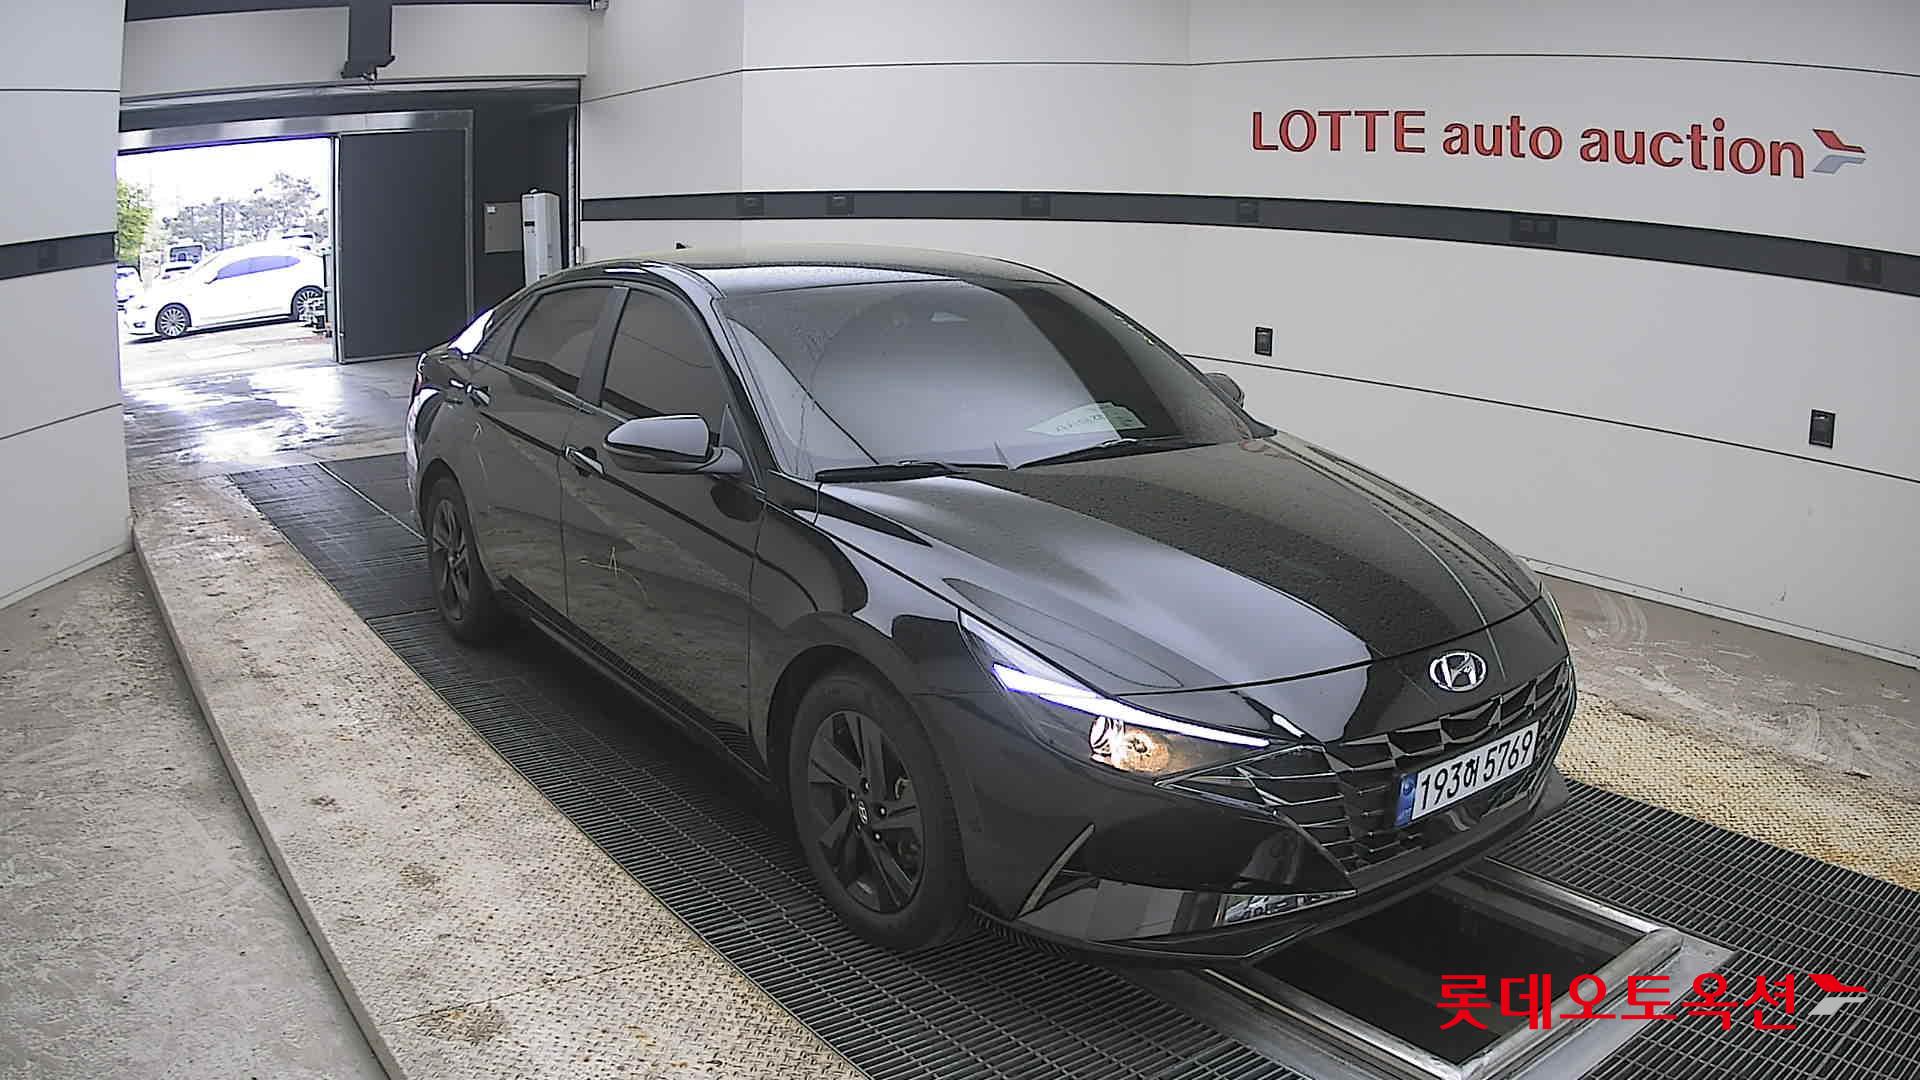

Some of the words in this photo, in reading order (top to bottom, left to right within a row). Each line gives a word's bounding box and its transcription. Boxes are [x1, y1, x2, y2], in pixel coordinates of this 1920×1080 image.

[1251, 109, 1426, 154] LOTTE
[1441, 114, 1563, 161] auto
[1578, 116, 1805, 179] auction
